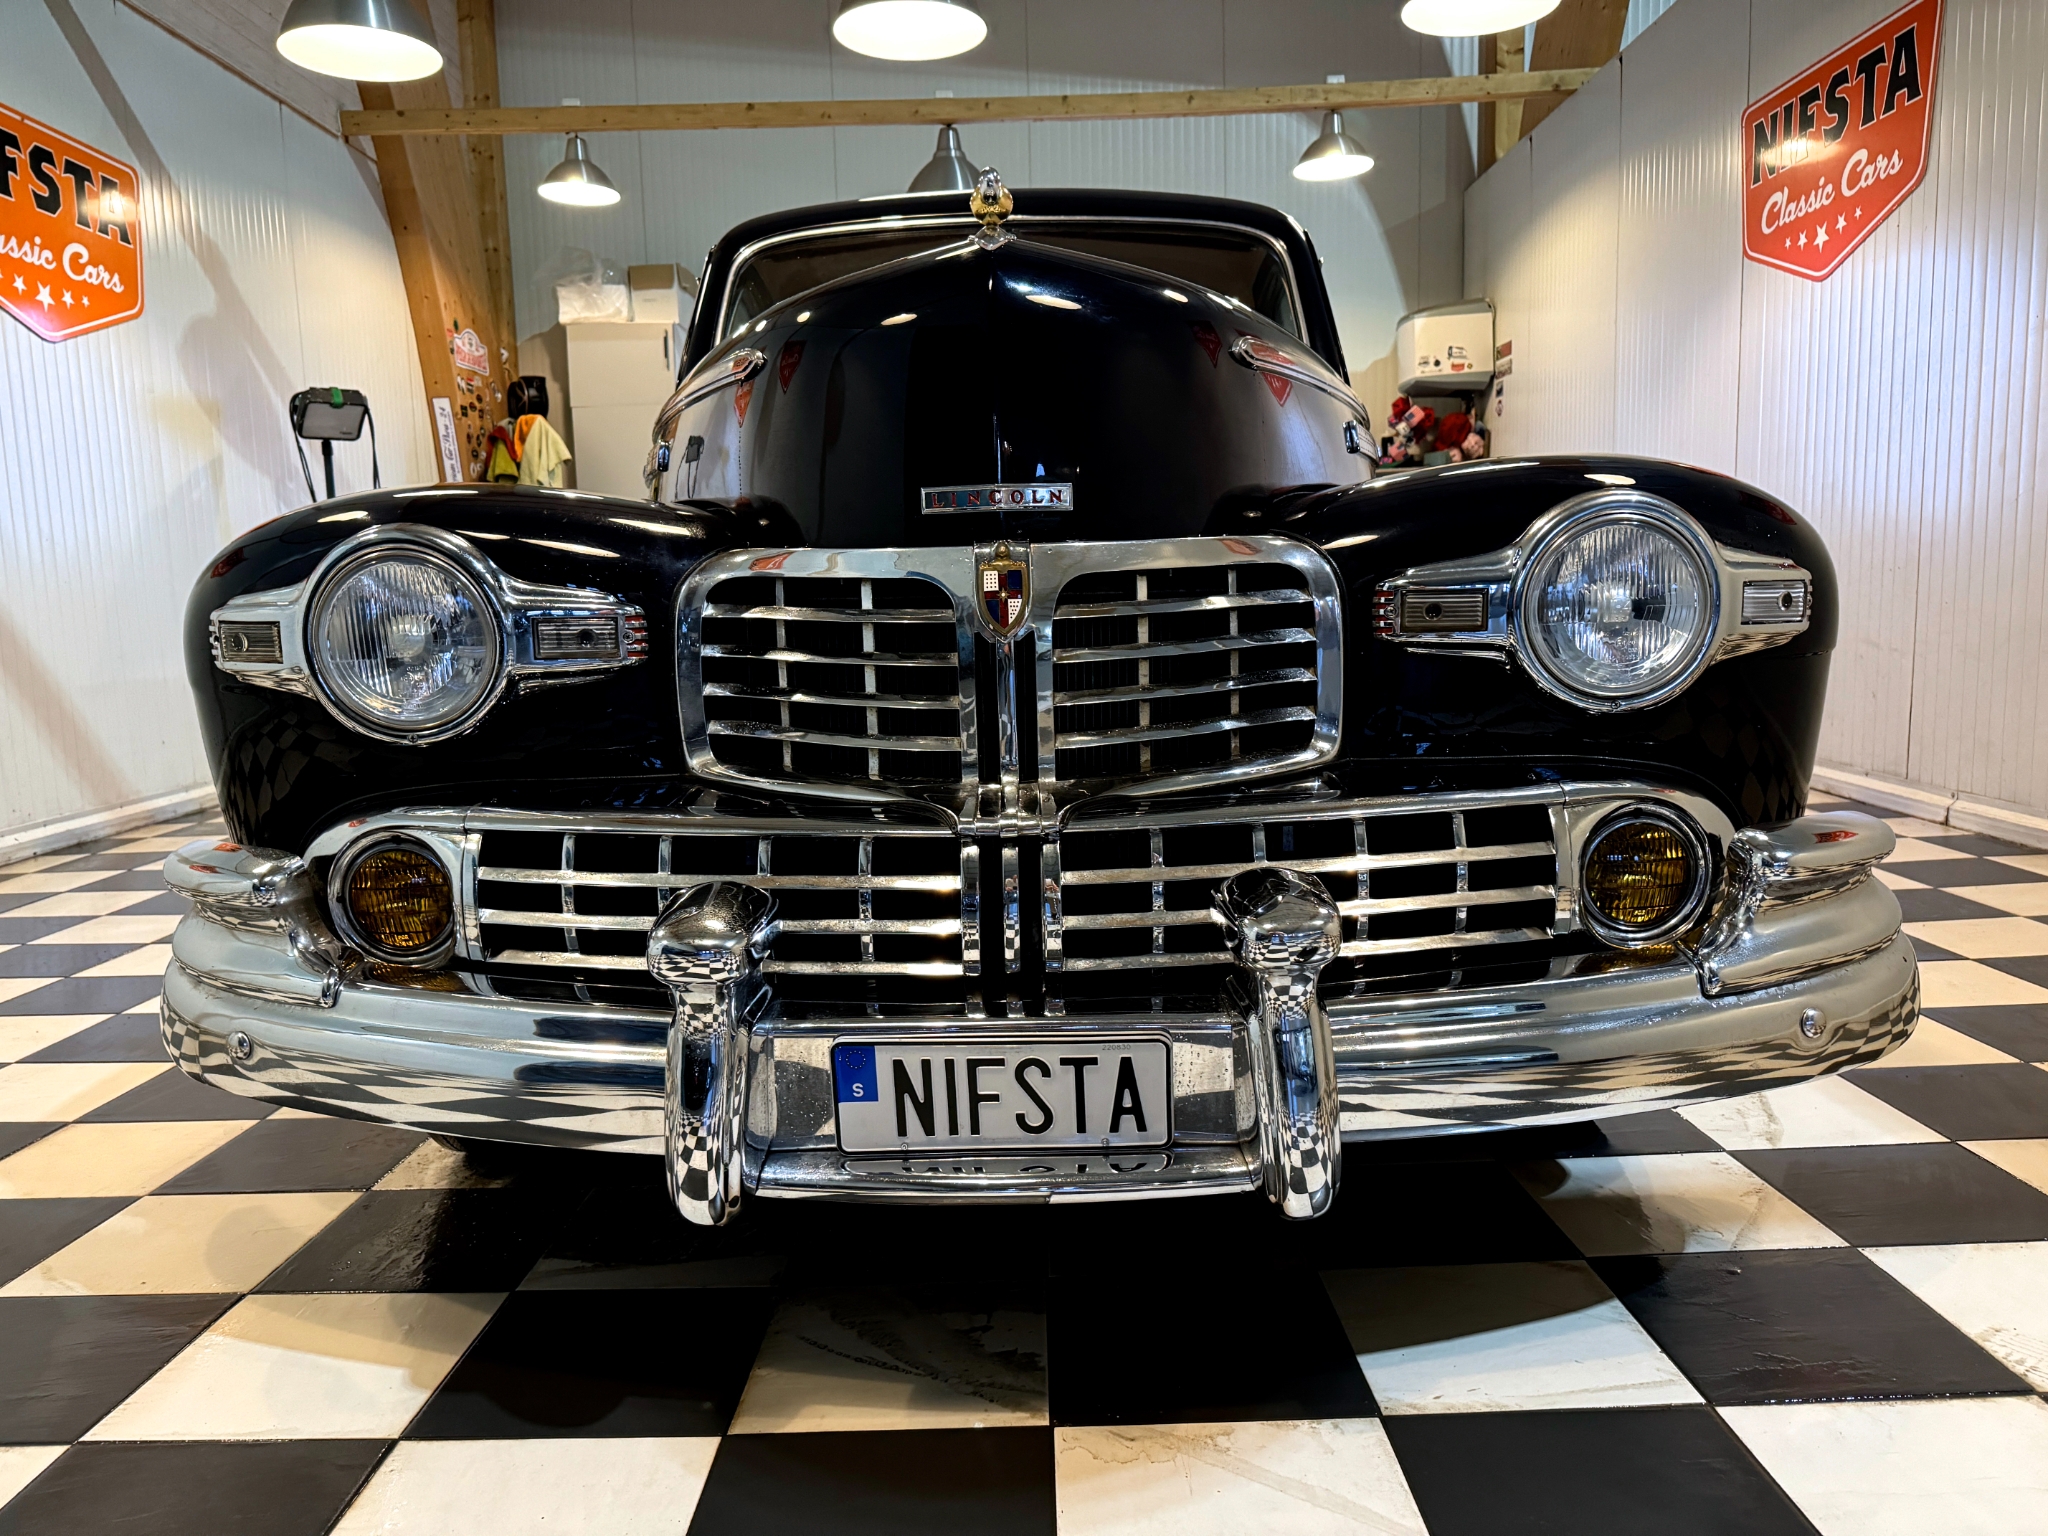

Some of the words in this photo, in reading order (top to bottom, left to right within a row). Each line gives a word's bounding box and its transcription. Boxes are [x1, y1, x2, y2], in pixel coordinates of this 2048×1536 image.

[1751, 22, 1923, 188] NIFSTA
[1761, 176, 1836, 235] Classic
[1841, 148, 1903, 197] Cars
[62, 242, 124, 294] Cars
[931, 489, 1064, 508] LINCOLN
[852, 1082, 864, 1098] S
[892, 1056, 1148, 1138] NIFSTA
